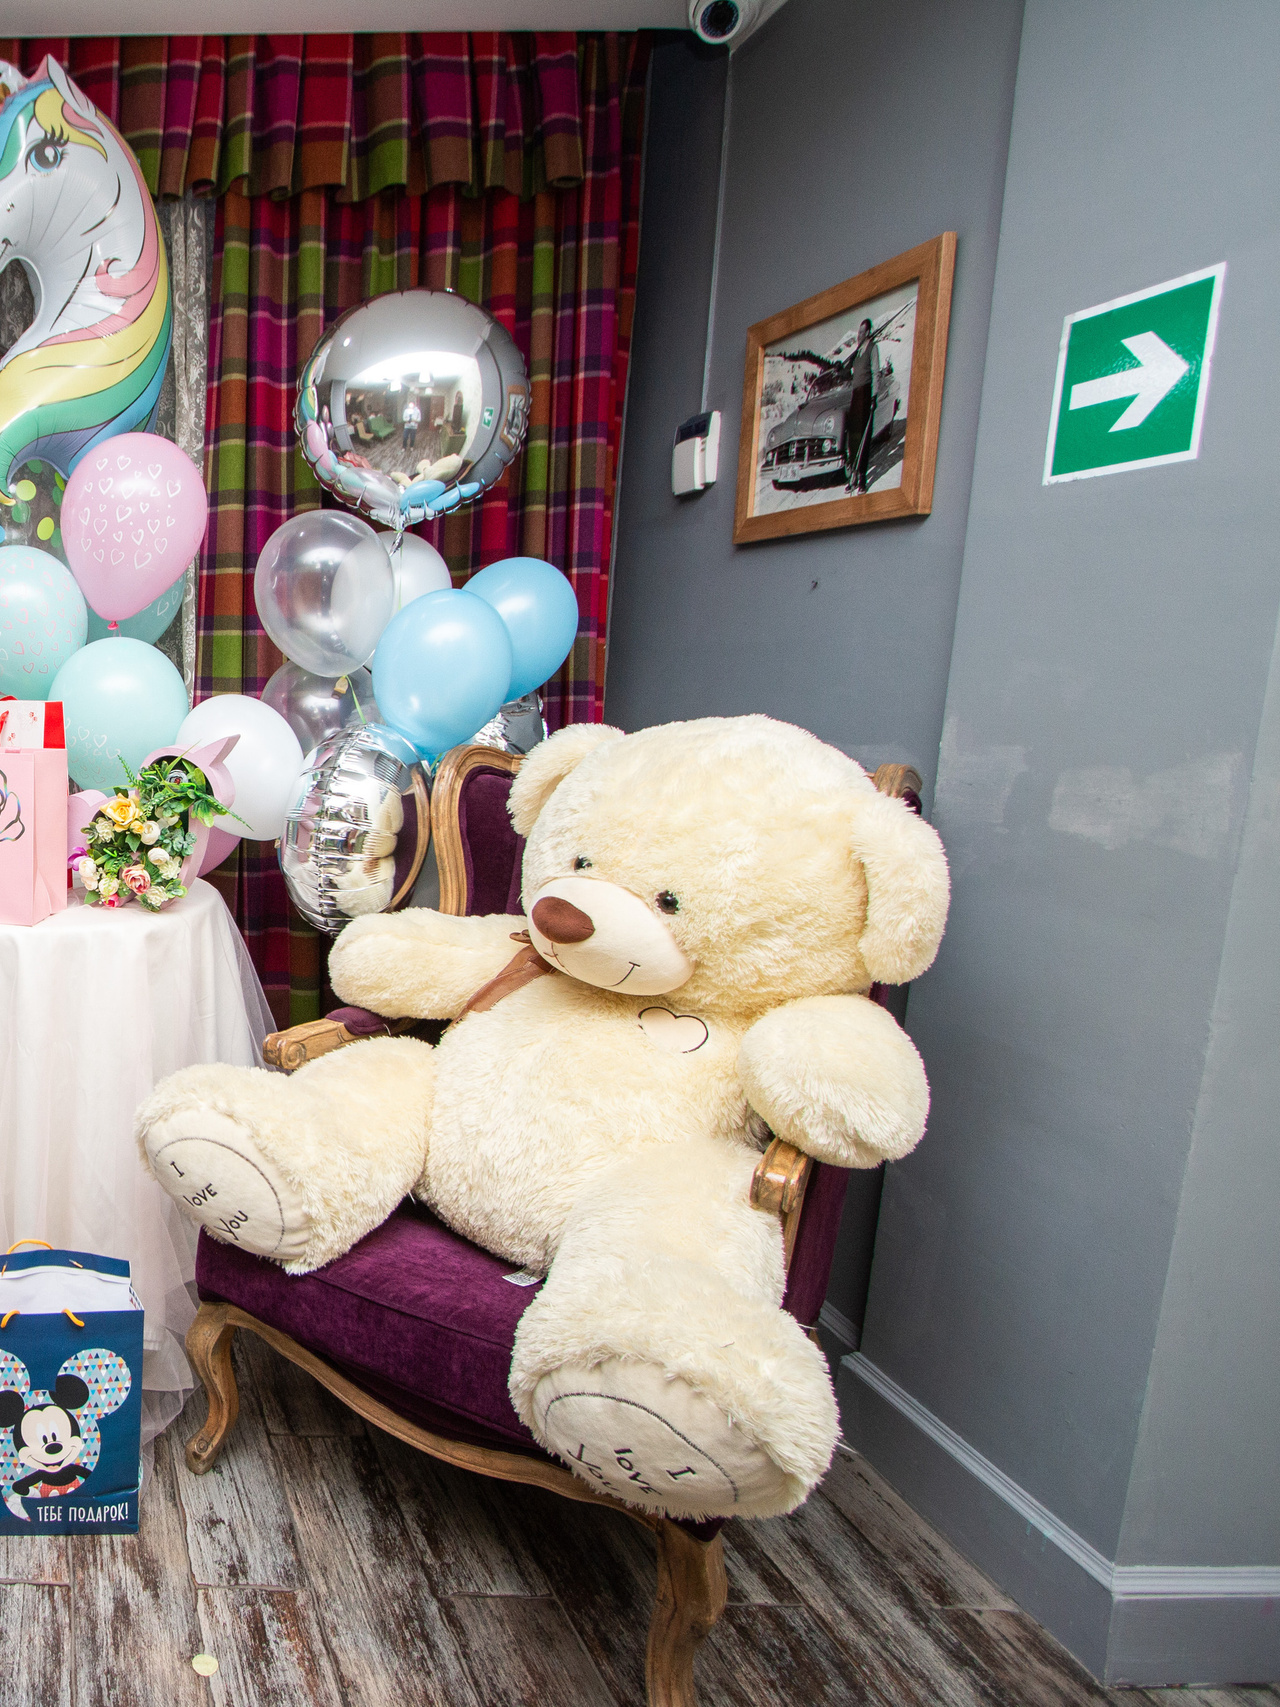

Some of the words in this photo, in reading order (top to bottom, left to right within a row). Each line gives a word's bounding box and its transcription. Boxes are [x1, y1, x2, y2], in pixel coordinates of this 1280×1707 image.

[170, 1161, 185, 1178] I
[666, 1466, 696, 1480] I
[36, 1505, 63, 1522] ТЕБЕ
[68, 1502, 129, 1522] ПОДАРОК!
